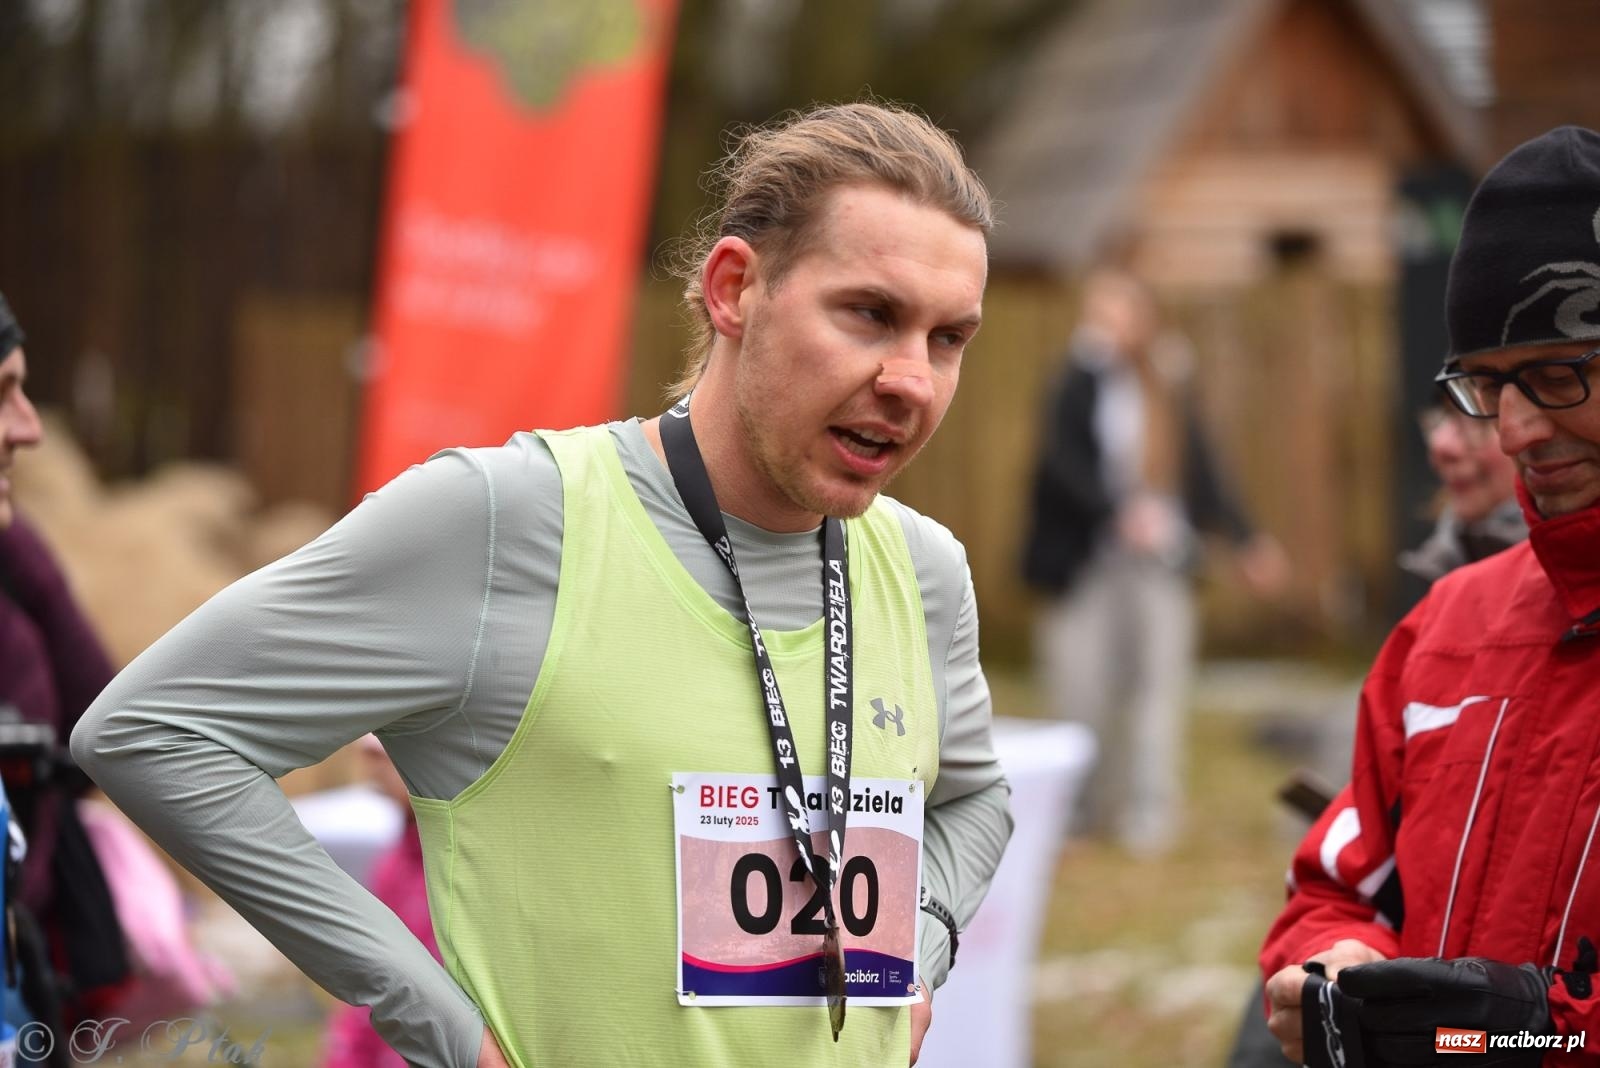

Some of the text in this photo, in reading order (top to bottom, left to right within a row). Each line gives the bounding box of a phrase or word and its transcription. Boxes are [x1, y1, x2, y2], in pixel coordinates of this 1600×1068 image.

[829, 559, 848, 815] 13 BIEG TWARDZIELA
[762, 668, 795, 769] 13 BIEG
[700, 785, 759, 809] BIEG
[700, 815, 759, 828] 23 luty 2025
[730, 853, 879, 937] 020
[844, 969, 880, 984] acibórz
